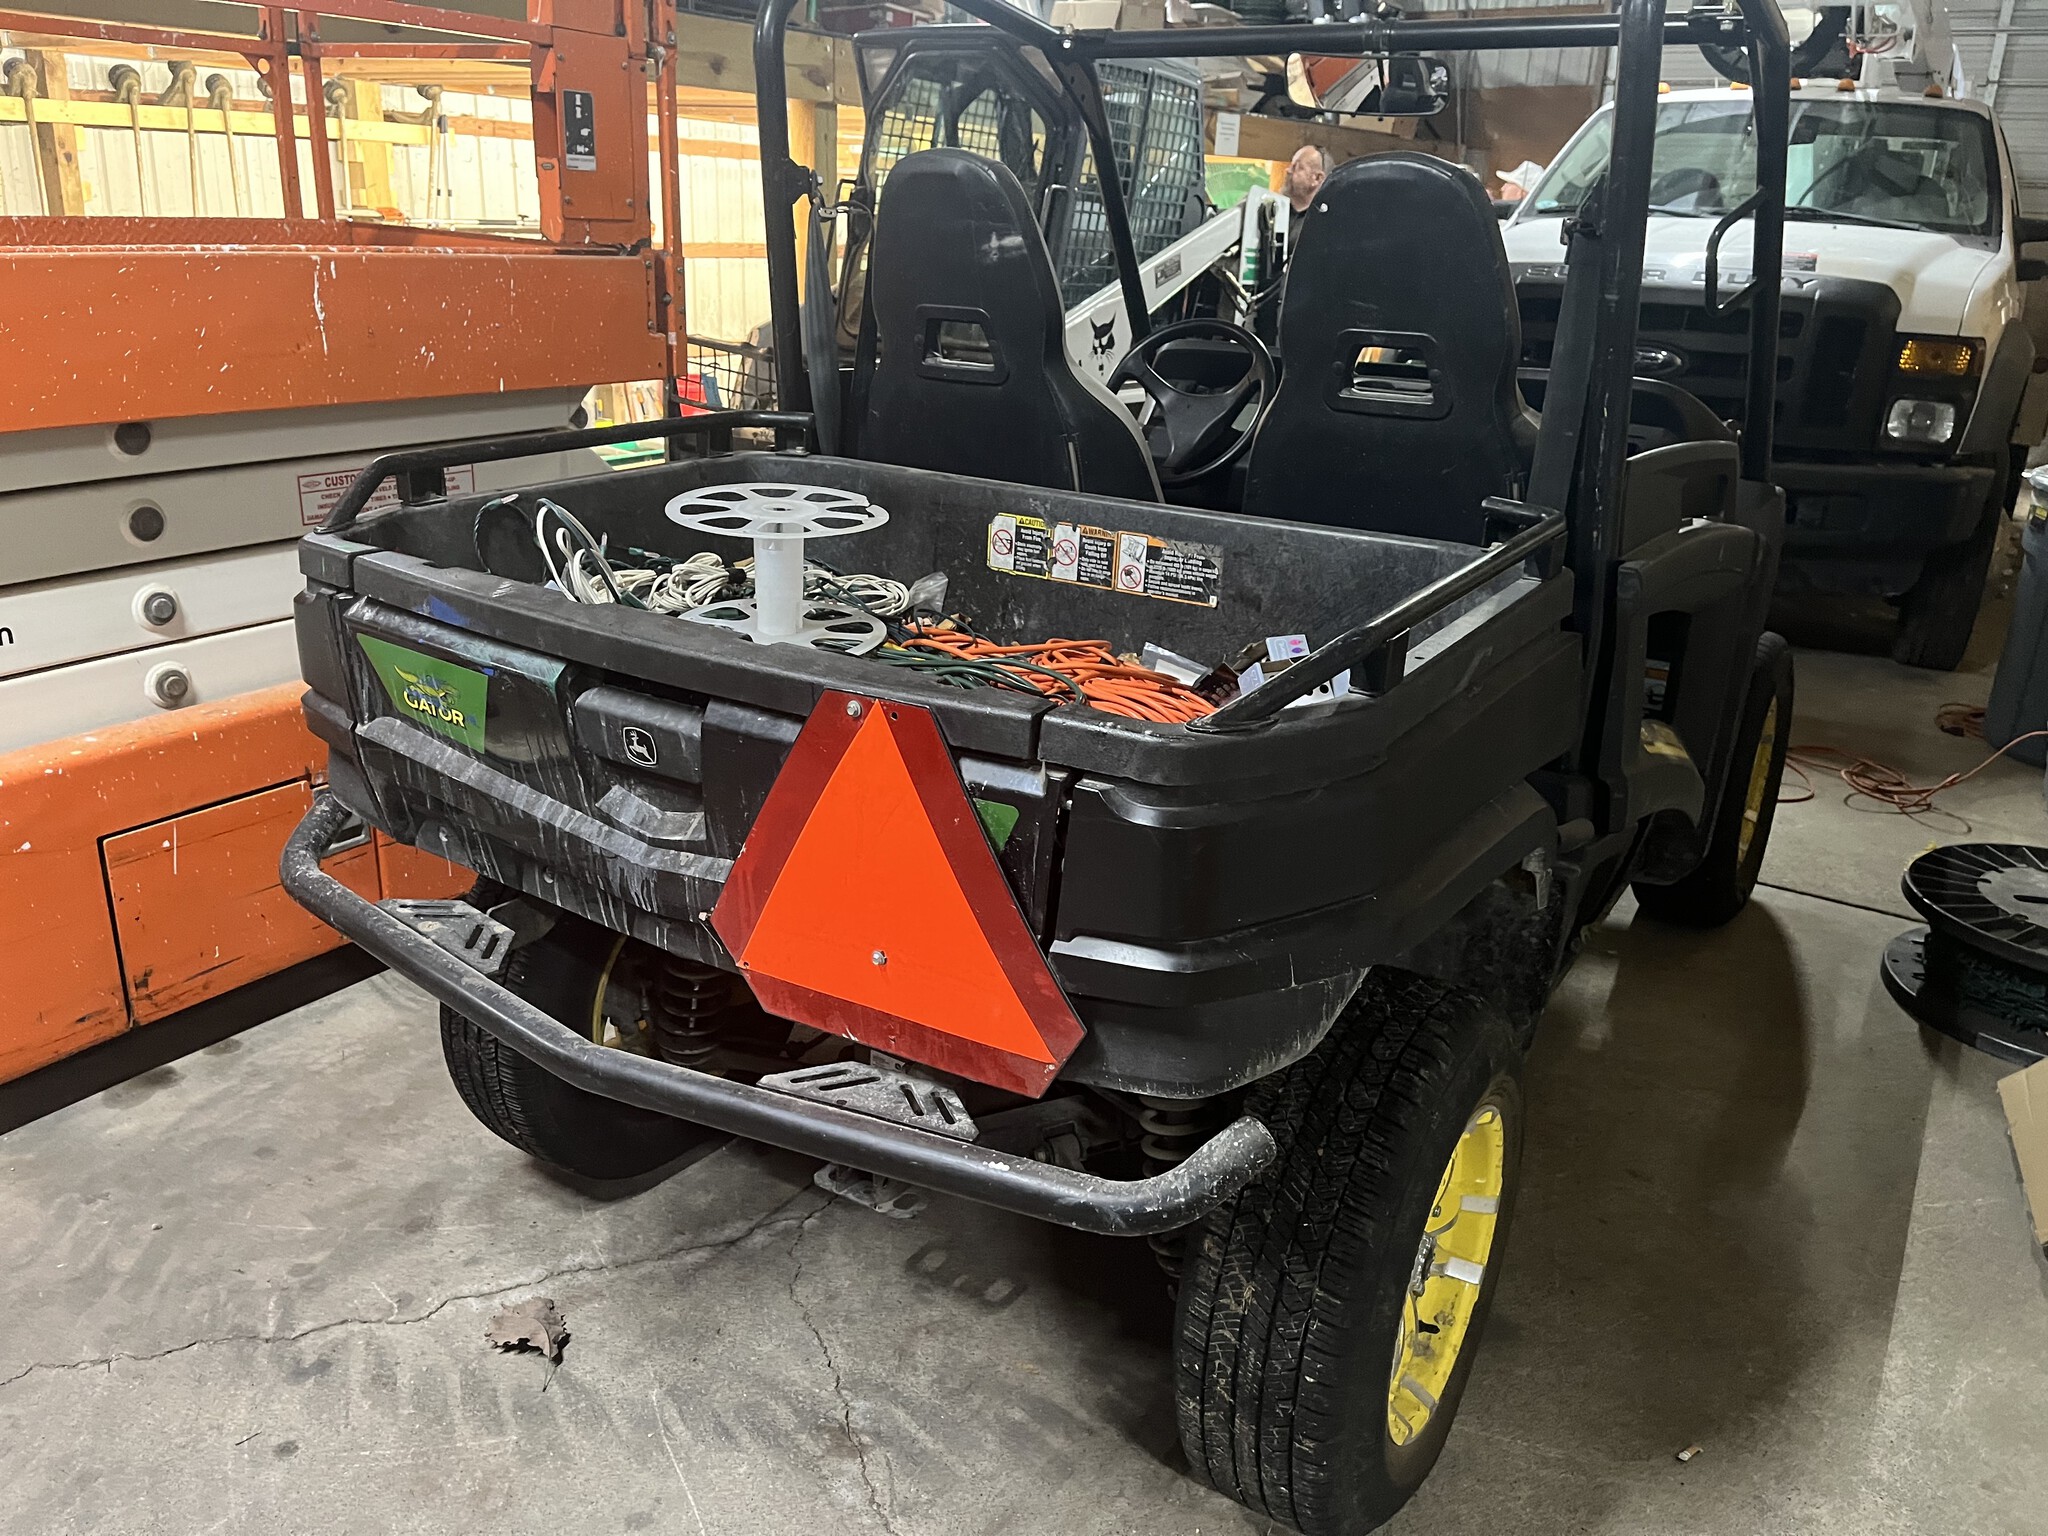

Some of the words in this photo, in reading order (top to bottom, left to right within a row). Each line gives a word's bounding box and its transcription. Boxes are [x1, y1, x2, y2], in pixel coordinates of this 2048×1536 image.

[324, 473, 358, 488] CUSTO
[1025, 518, 1046, 528] CAUTIO
[403, 690, 466, 730] GATOR
